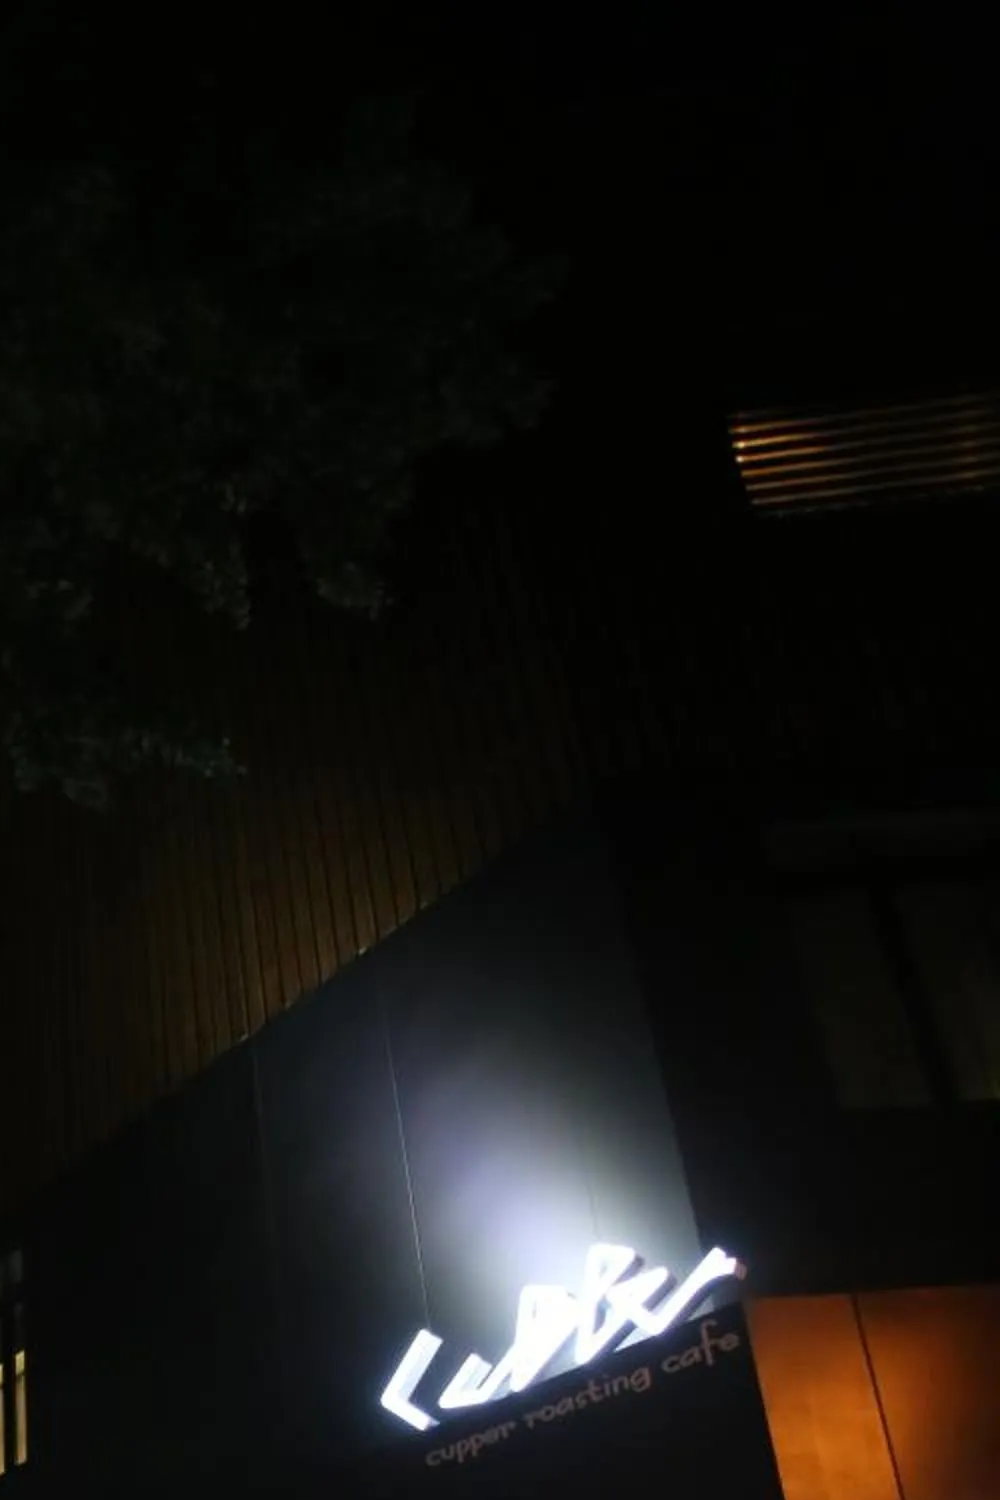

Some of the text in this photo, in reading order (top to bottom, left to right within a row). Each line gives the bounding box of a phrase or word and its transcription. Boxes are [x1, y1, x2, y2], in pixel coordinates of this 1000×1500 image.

[424, 1317, 741, 1468] cupper roasting cafe
